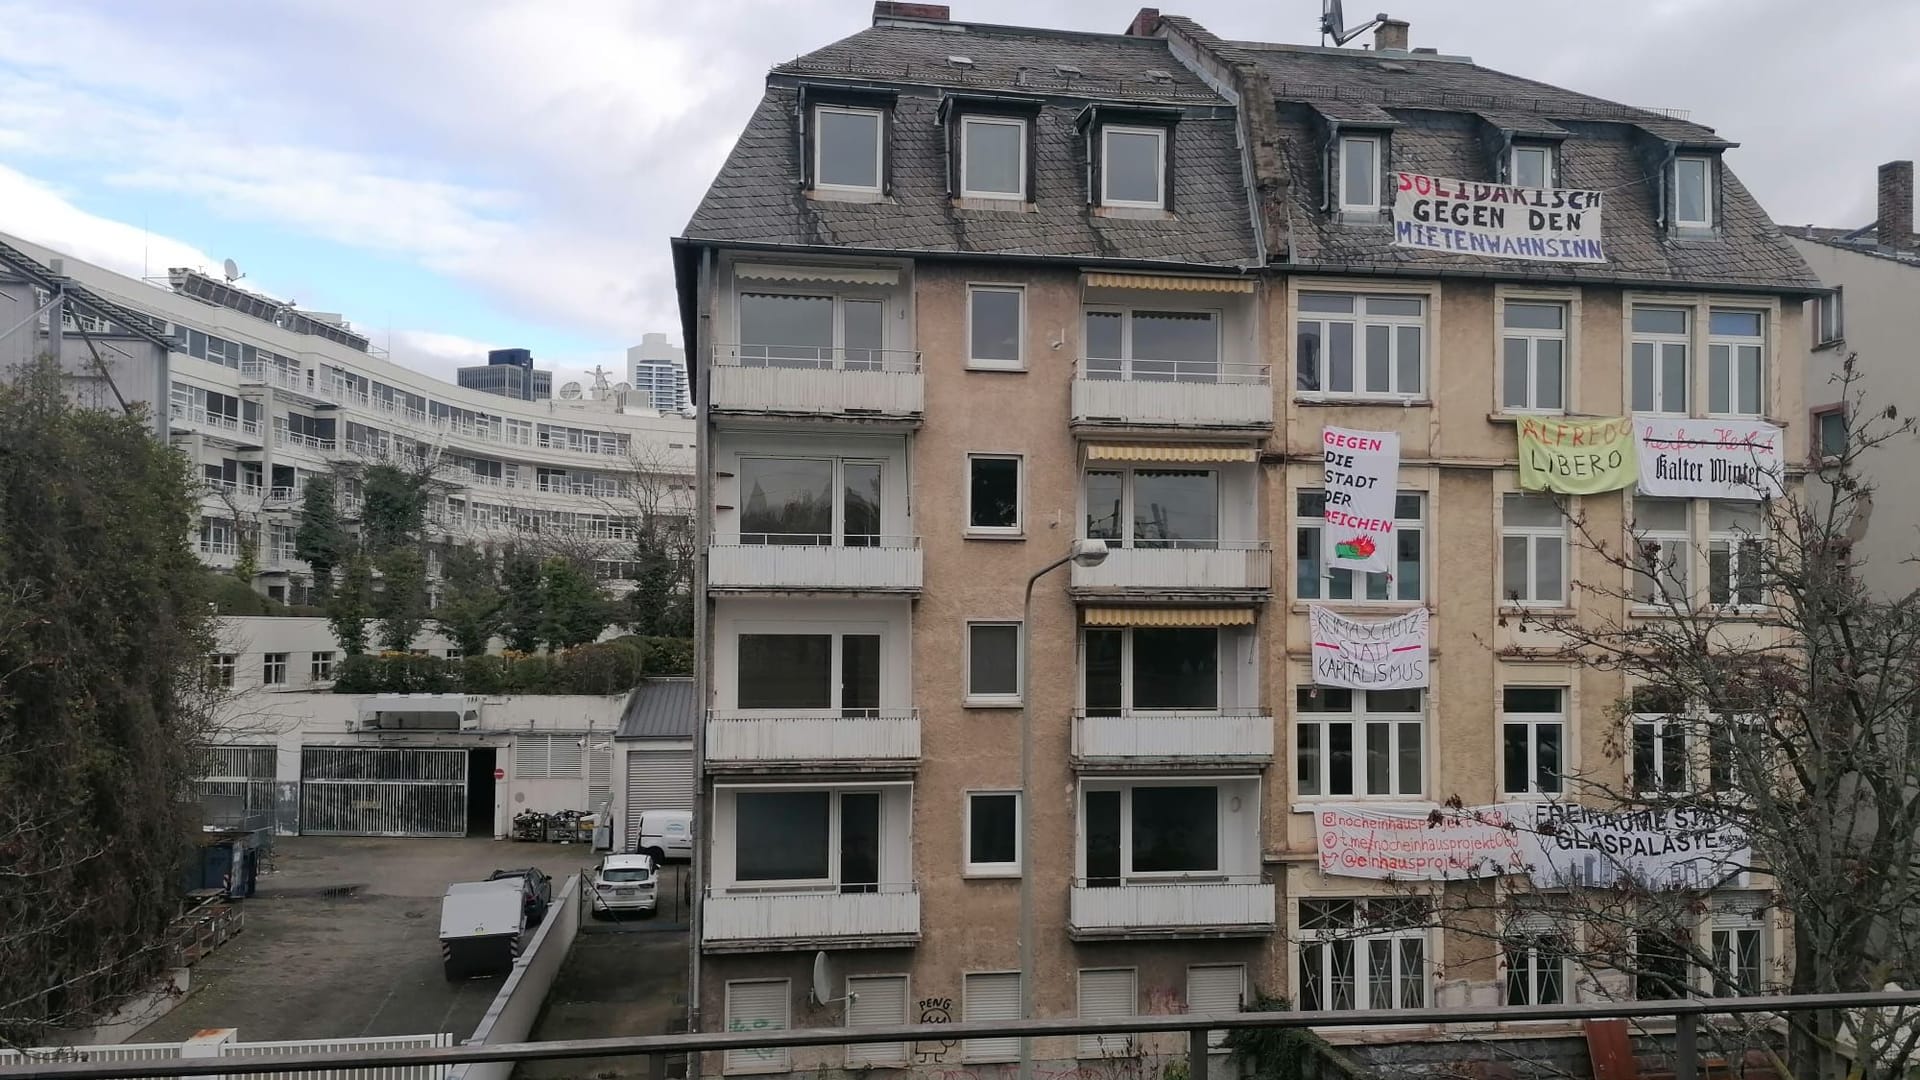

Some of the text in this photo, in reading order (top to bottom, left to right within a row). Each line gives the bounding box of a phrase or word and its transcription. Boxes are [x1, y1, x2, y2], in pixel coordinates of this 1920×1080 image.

[1399, 172, 1600, 210] SOLIDARISCH
[1413, 200, 1582, 231] GEGEN DEN
[1397, 221, 1603, 260] MIETENWAHNSINN
[1324, 431, 1382, 451] GEGEN
[1522, 419, 1633, 447] ALFREDO
[1325, 451, 1354, 468] DIE
[1531, 449, 1622, 477] LIBERO
[1655, 454, 1760, 485] Kalter Winter
[1325, 470, 1378, 489] STADT
[1325, 490, 1352, 508] DER
[1324, 510, 1393, 533] REICHEN
[1339, 640, 1391, 661] STATT
[1318, 656, 1423, 683] KAPITALISMUS
[1556, 828, 1718, 856] GLASPALÄSTE
